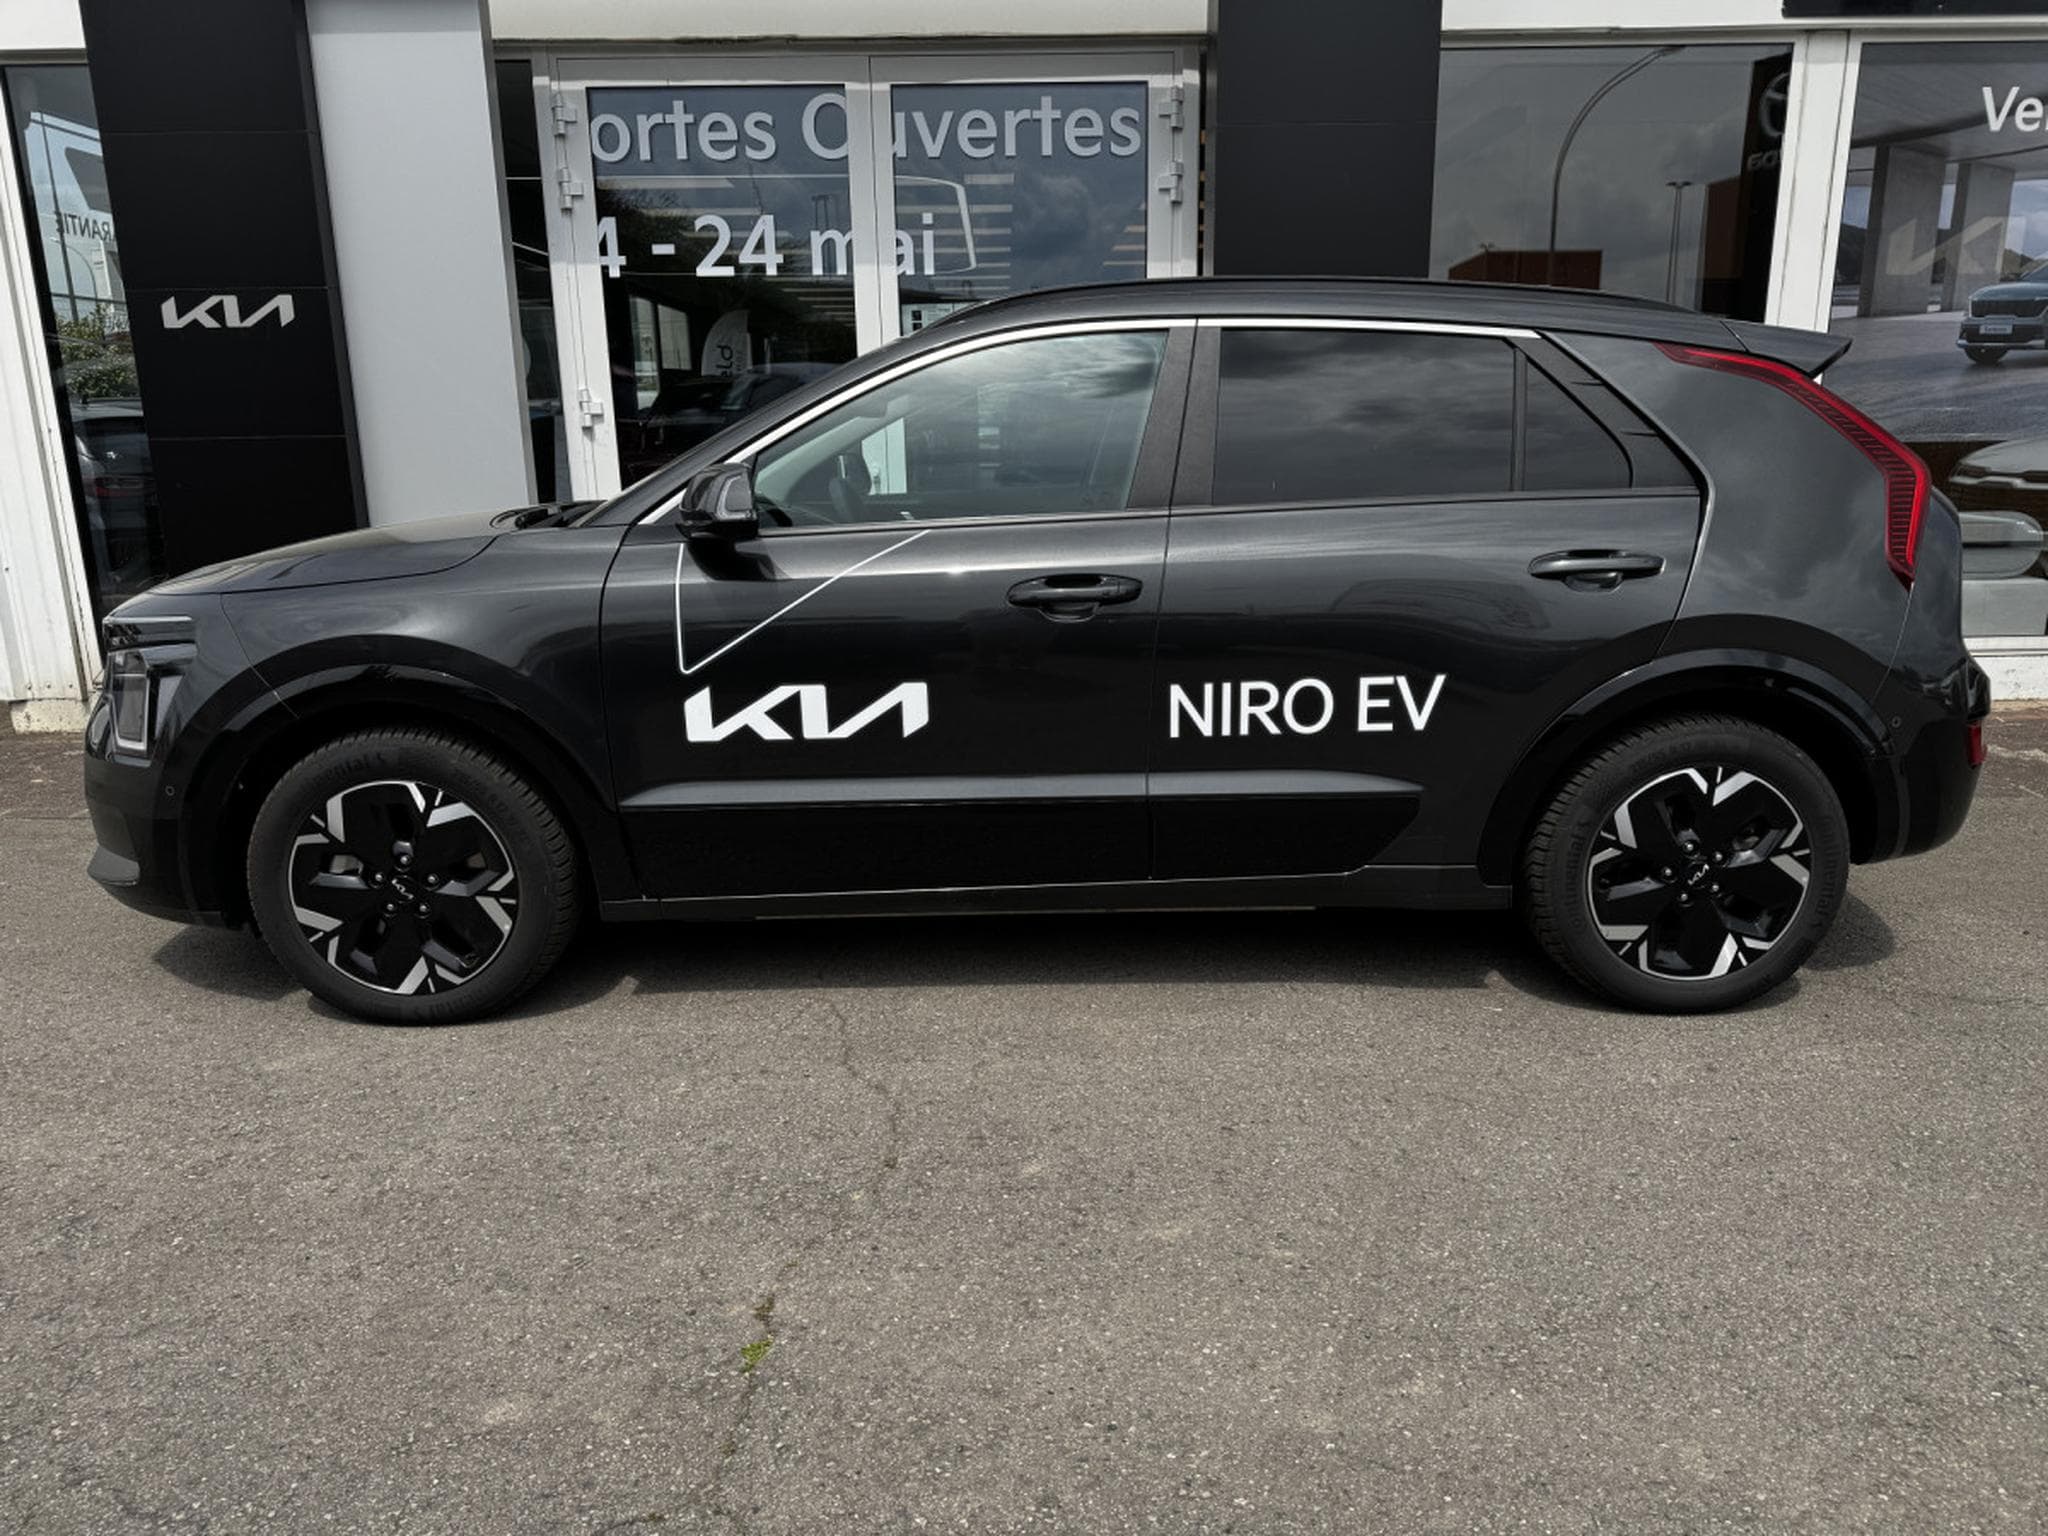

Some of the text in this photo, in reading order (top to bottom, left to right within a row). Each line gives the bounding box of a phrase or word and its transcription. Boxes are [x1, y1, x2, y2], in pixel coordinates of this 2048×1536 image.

[1982, 86, 2048, 132] Ve
[694, 214, 784, 278] 24
[160, 294, 295, 329] KIA
[684, 682, 929, 742] KIA
[1169, 673, 1448, 739] NIRO EV
